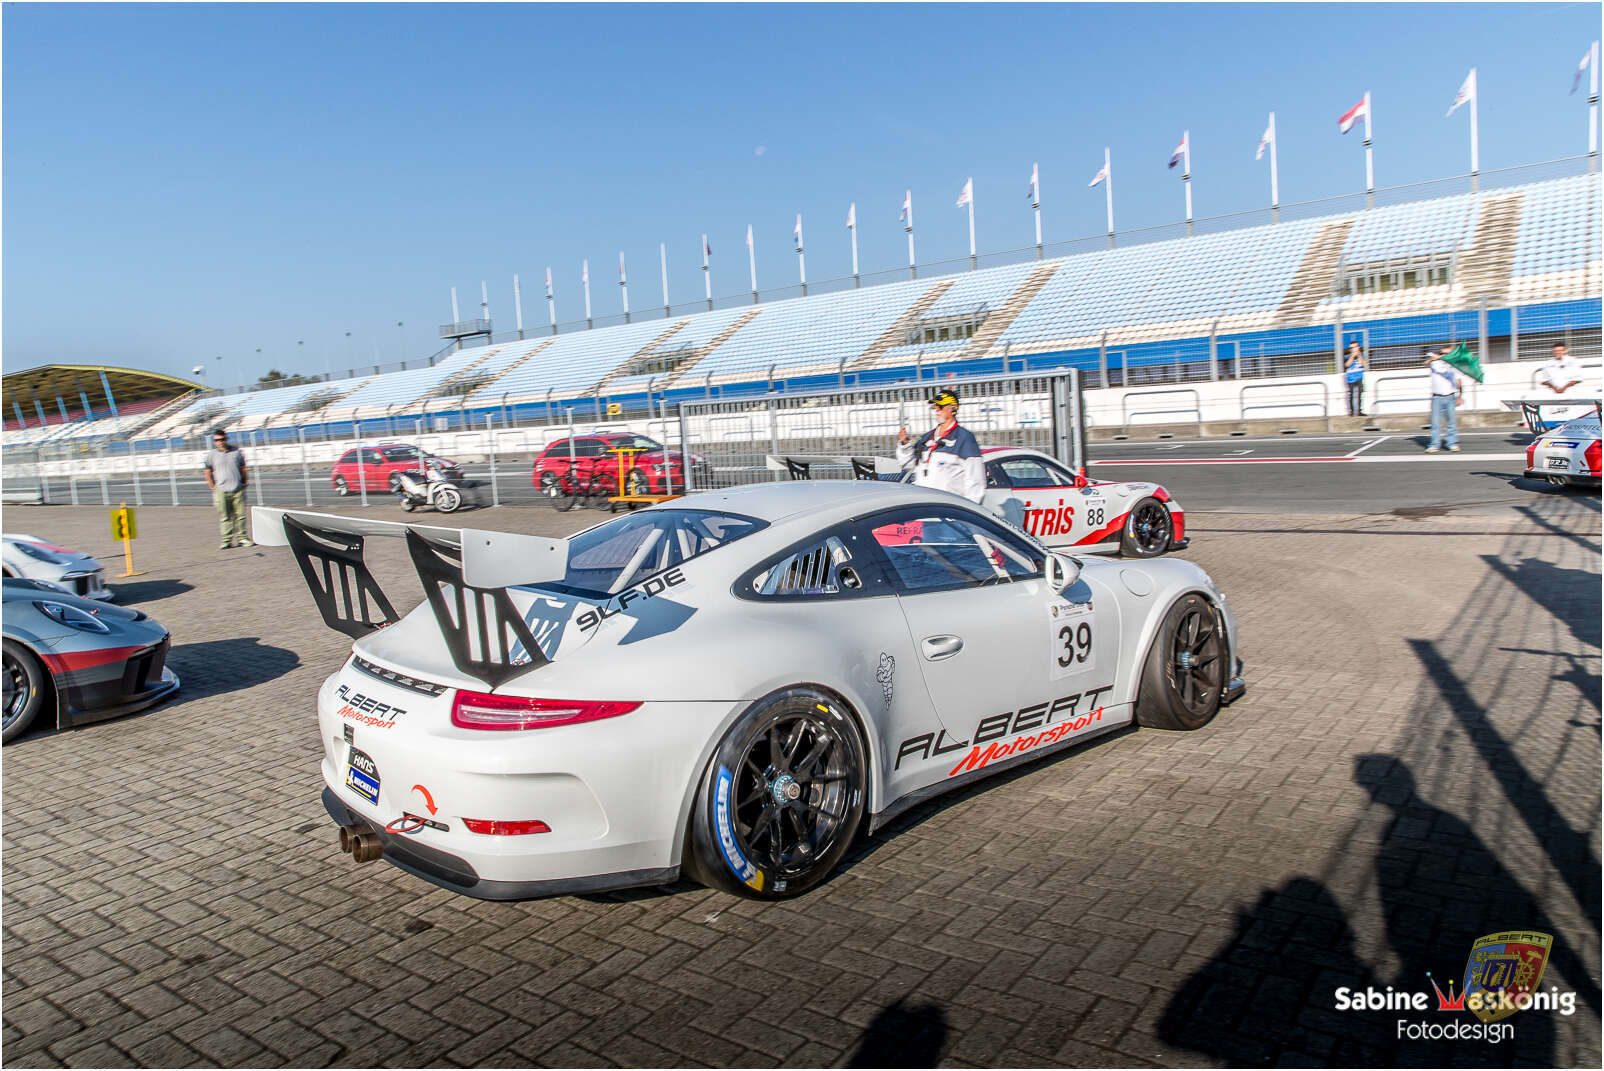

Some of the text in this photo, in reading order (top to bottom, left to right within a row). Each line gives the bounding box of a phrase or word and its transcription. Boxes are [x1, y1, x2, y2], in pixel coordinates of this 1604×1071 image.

[1087, 508, 1104, 526] 88
[576, 568, 686, 632] 9LF.DE
[1058, 621, 1092, 668] 39
[334, 684, 408, 721] ALBERT
[336, 704, 396, 729] Motorsport
[894, 684, 1114, 771] ALBERT
[949, 706, 1104, 777] Motorsport
[353, 776, 378, 796] MICHELIN
